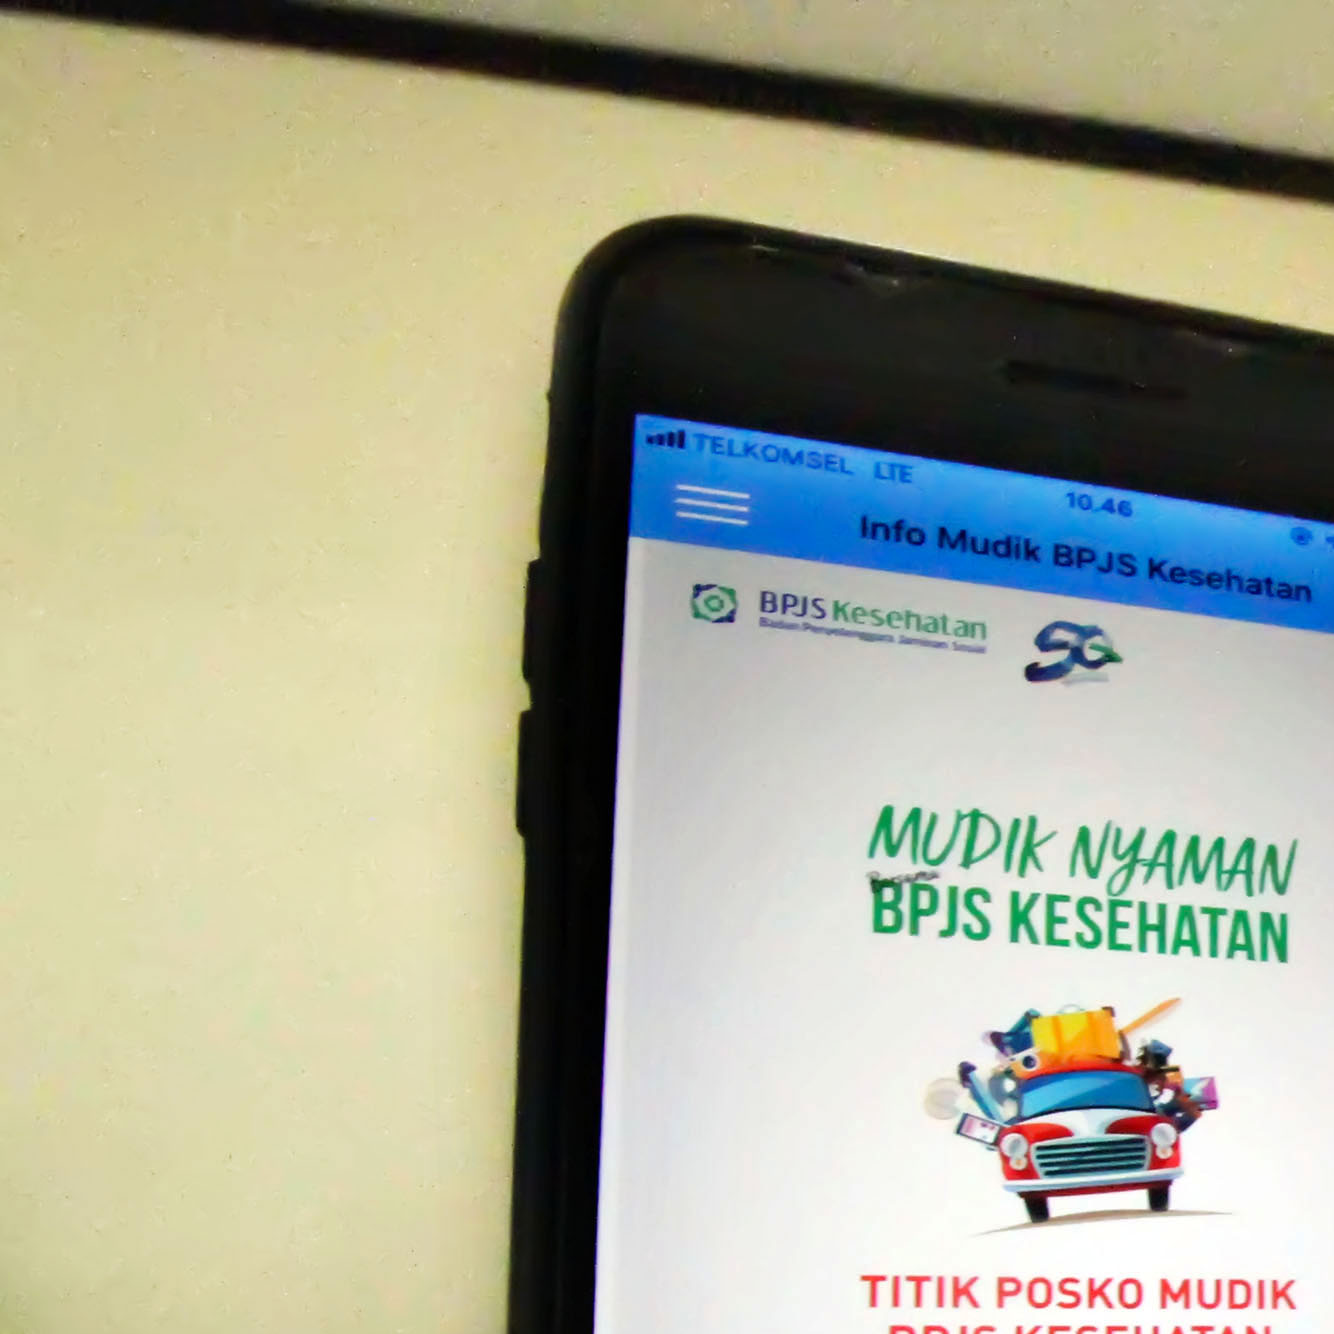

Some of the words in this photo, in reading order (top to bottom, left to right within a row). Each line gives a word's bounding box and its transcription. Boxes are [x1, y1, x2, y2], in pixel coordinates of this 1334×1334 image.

[693, 432, 854, 475] TELKOMSEL
[874, 461, 914, 483] LTE
[860, 515, 925, 546] Info
[938, 526, 1041, 562] Mudik
[1053, 543, 1138, 577] BPJS
[1148, 557, 1312, 603] Kesehatan
[760, 590, 827, 619] BPJS
[832, 600, 987, 640] Kesehatan
[868, 805, 1057, 878] MUDIK
[1069, 819, 1298, 897] NYAMAN
[872, 880, 993, 941] BPJS
[1009, 890, 1290, 964] KESEHATAN
[860, 1275, 981, 1308] TITIK
[996, 1277, 1144, 1310] POSKO
[1159, 1279, 1297, 1310] MUDIK
